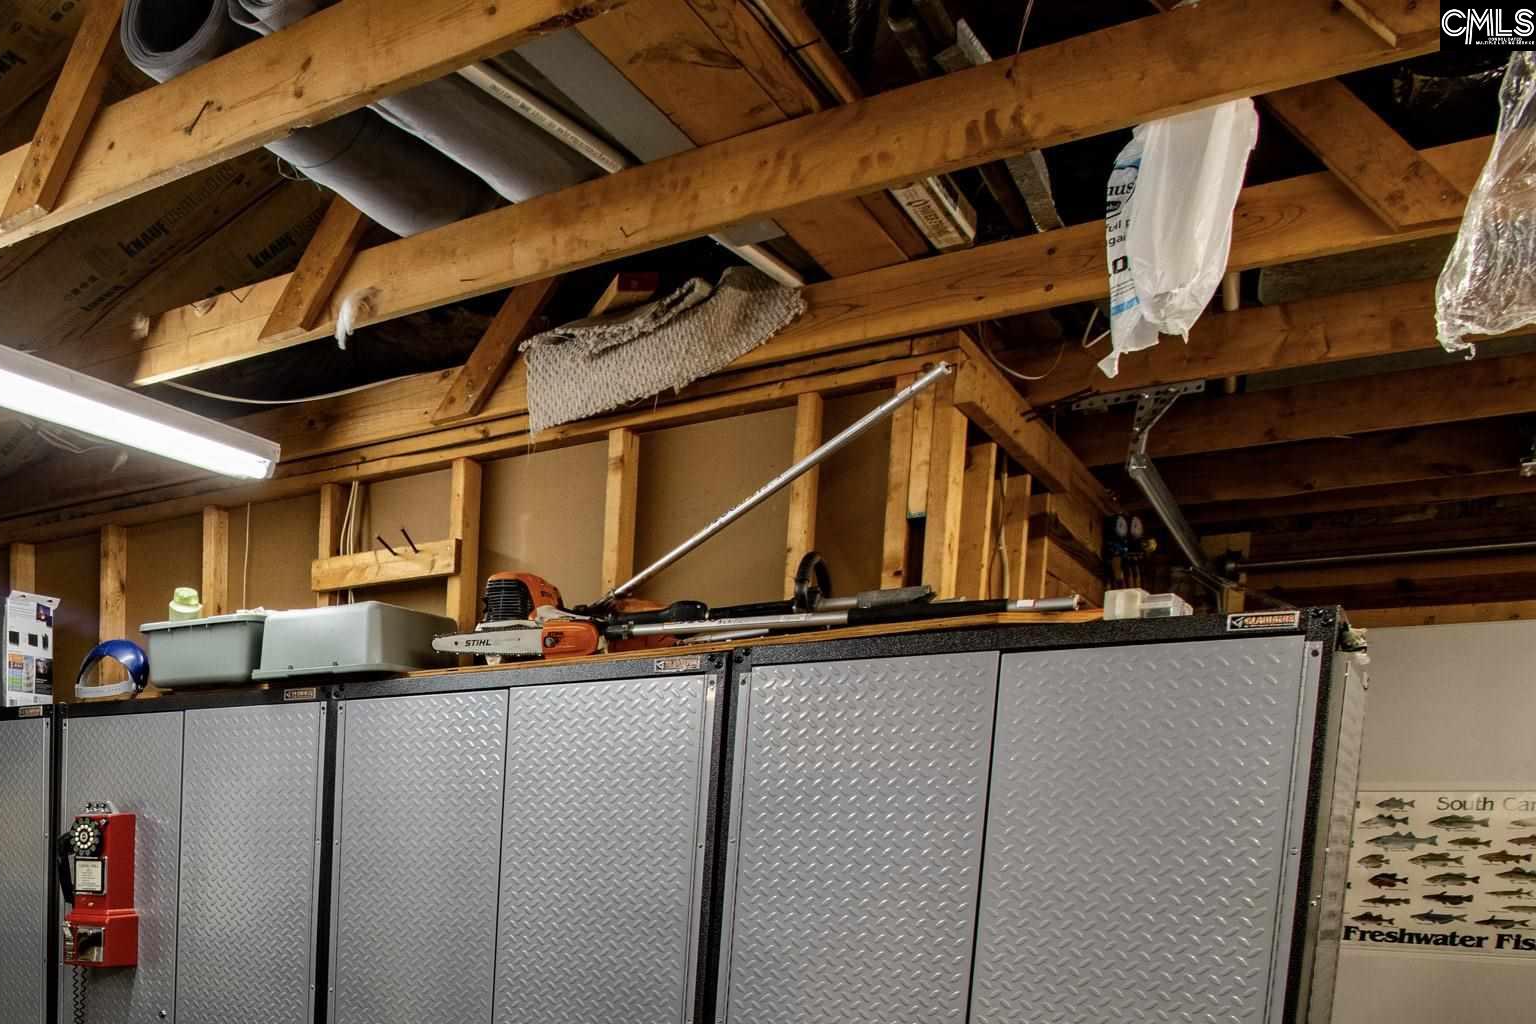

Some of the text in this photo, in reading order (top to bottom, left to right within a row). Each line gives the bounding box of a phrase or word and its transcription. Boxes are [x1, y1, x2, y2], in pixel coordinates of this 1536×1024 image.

[465, 639, 492, 647] STIHL
[1436, 796, 1494, 812] South
[1343, 925, 1489, 948] Freshwater
